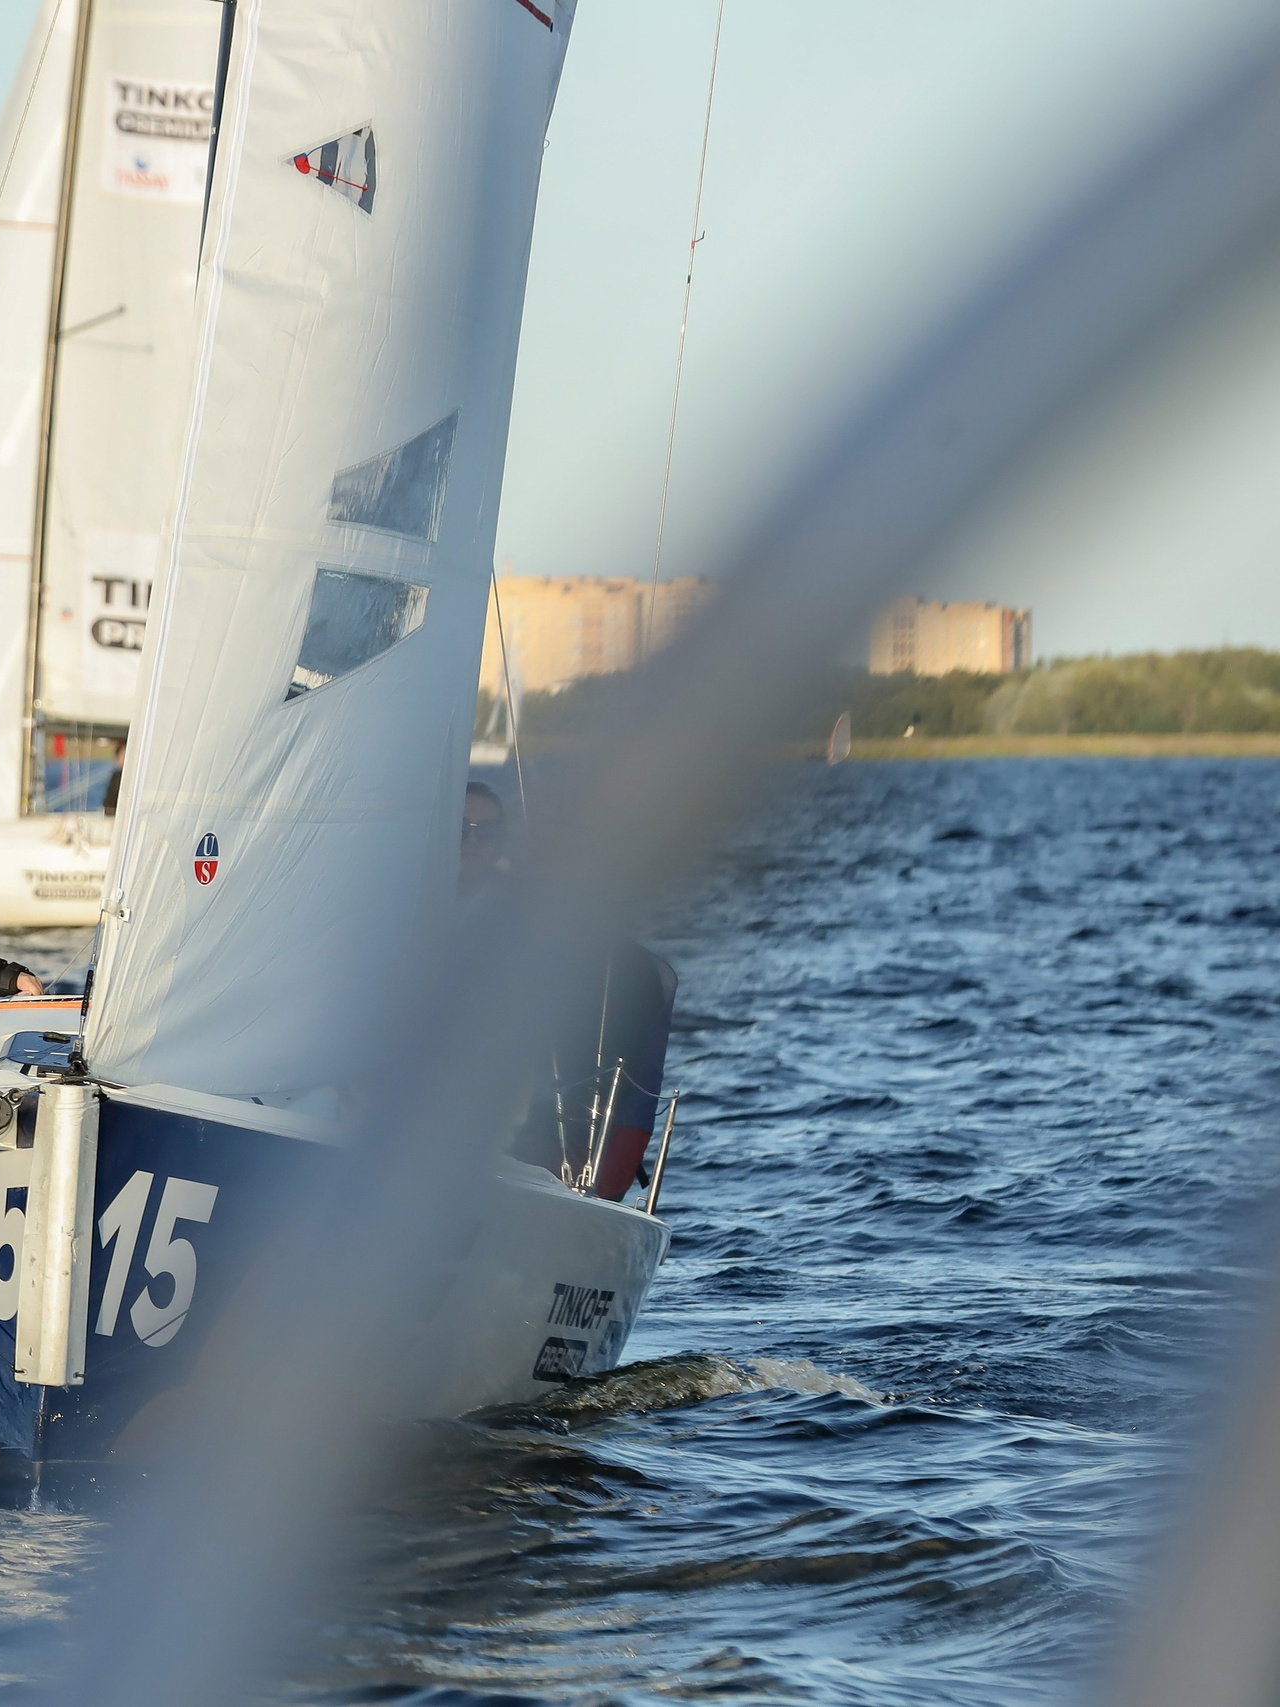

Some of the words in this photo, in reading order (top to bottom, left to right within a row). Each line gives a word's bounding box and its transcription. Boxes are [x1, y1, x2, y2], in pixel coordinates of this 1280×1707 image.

[116, 80, 215, 111] TINKO
[94, 1169, 220, 1348] 15
[547, 1282, 616, 1330] TINKOFF
